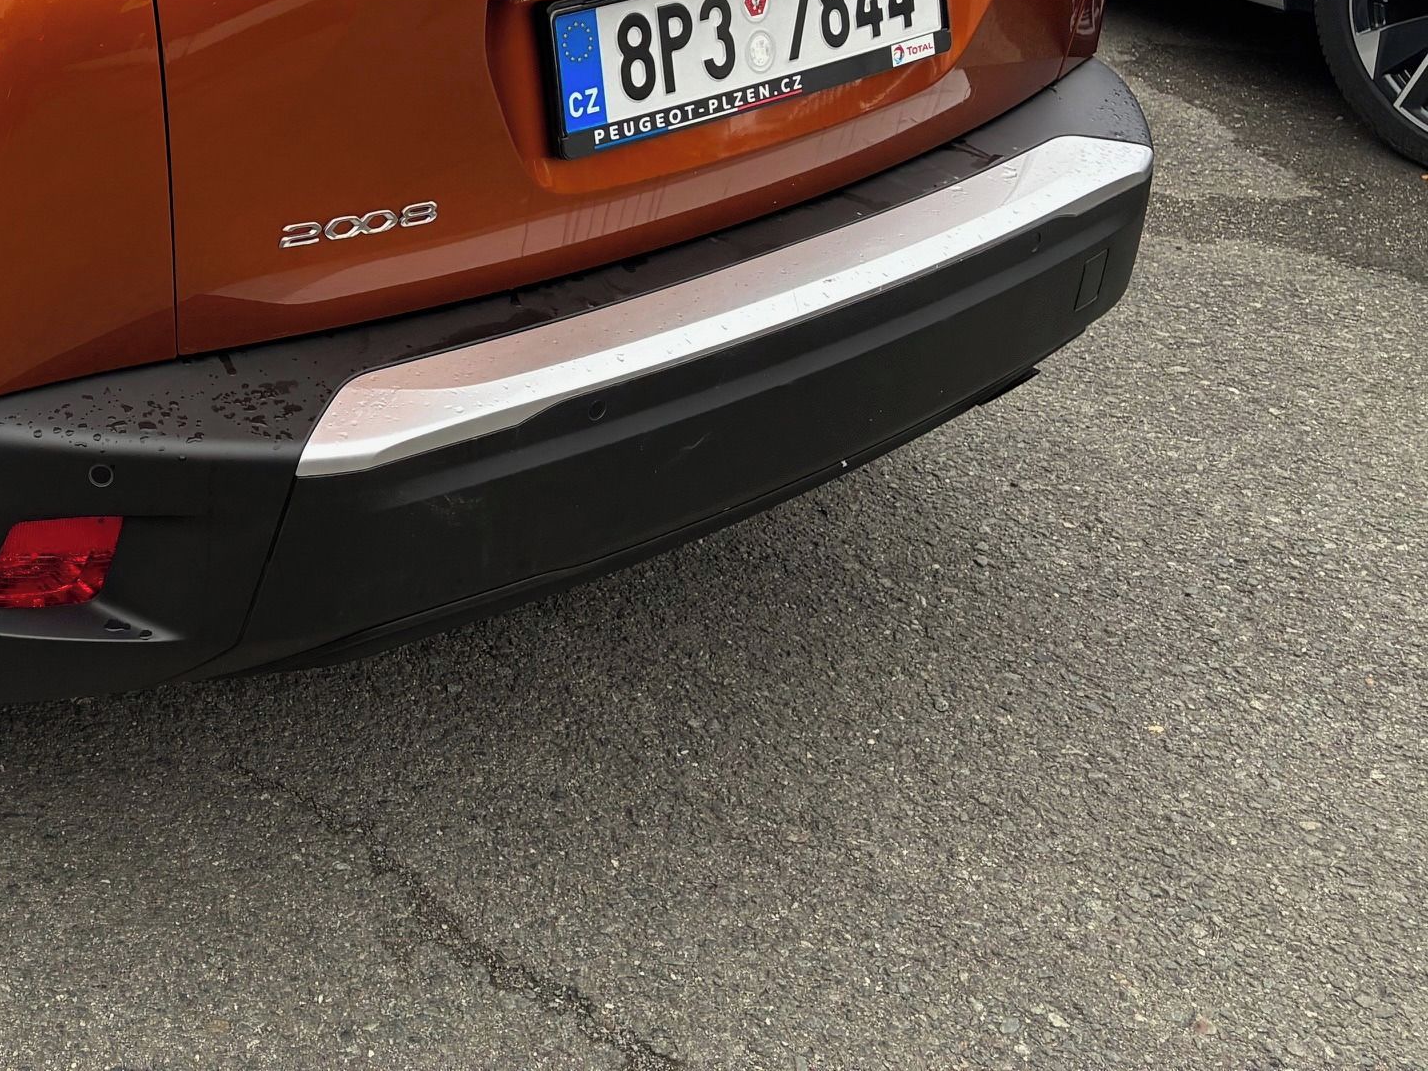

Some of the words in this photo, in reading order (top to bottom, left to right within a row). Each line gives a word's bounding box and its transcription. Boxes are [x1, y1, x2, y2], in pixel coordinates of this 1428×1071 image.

[906, 42, 934, 56] TOTAL
[568, 85, 600, 119] CZ
[593, 74, 803, 145] PEUGEOT-PLZEN.CZ
[278, 200, 438, 249] 2008
